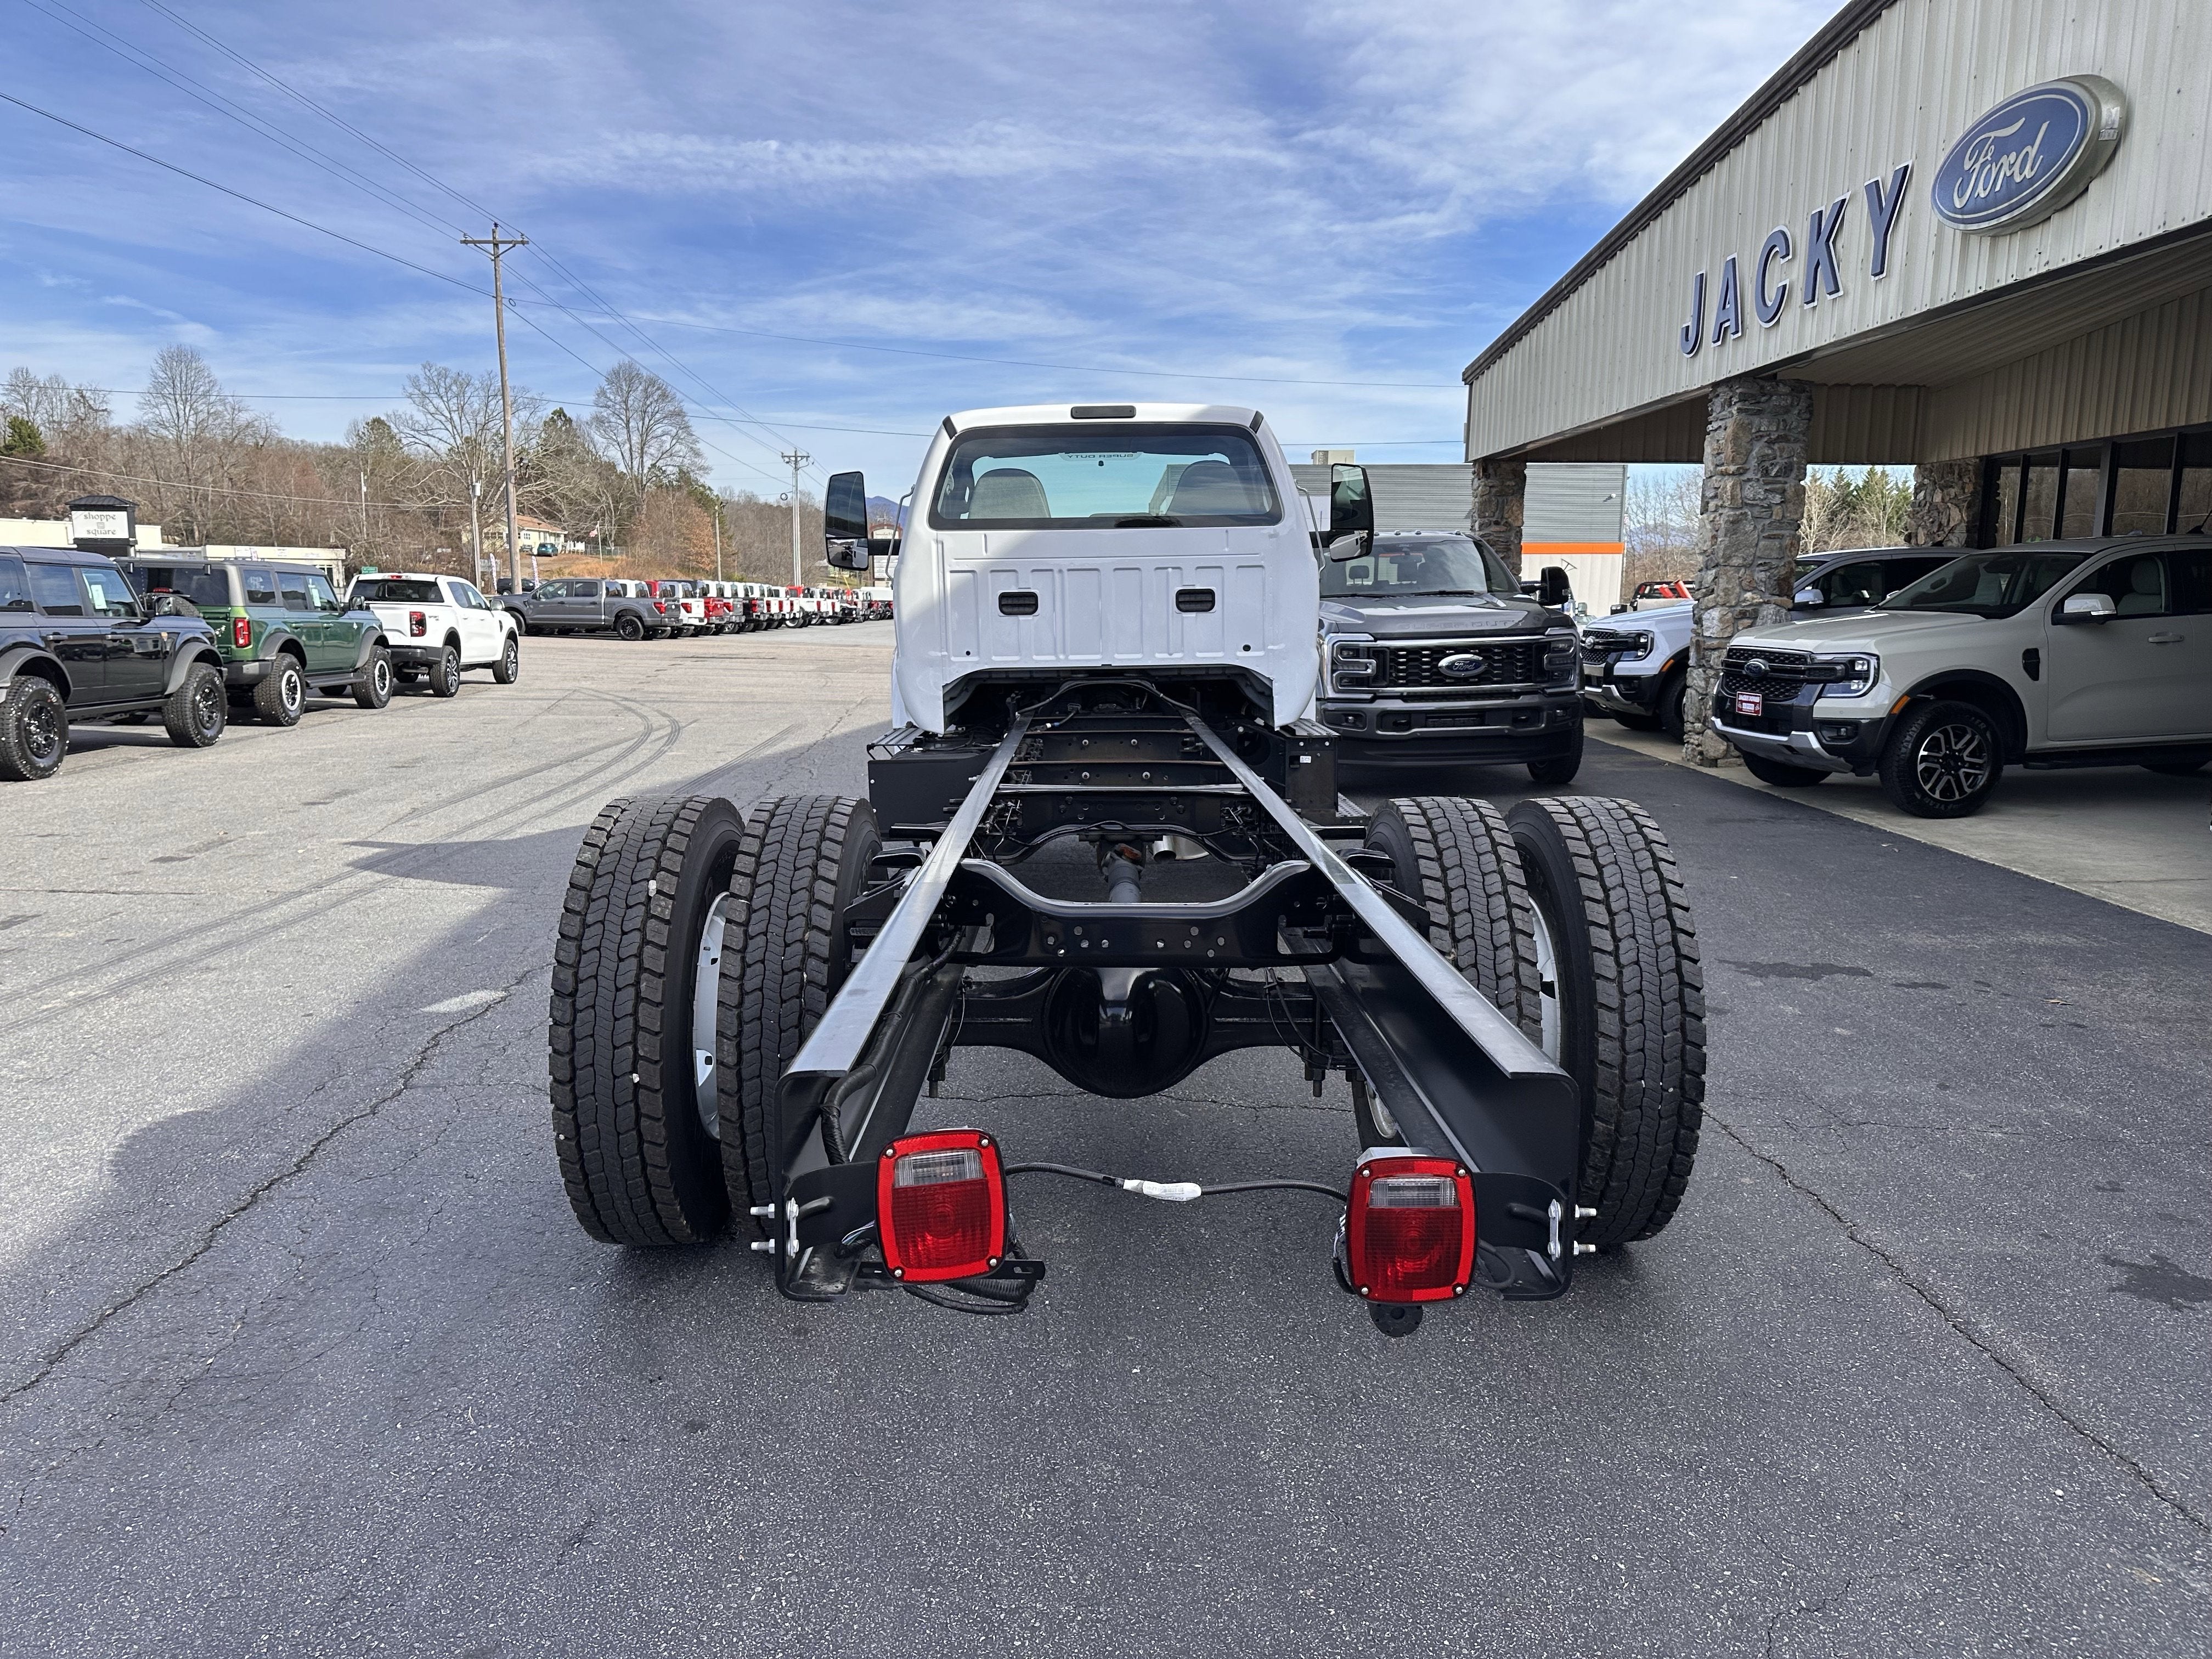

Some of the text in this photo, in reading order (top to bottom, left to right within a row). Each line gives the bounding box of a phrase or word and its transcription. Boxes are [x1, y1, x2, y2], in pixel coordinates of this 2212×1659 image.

[1953, 117, 2050, 209] Ford
[1680, 160, 1913, 358] JACKY
[83, 512, 116, 522] shoppe
[1453, 660, 1476, 670] Ford
